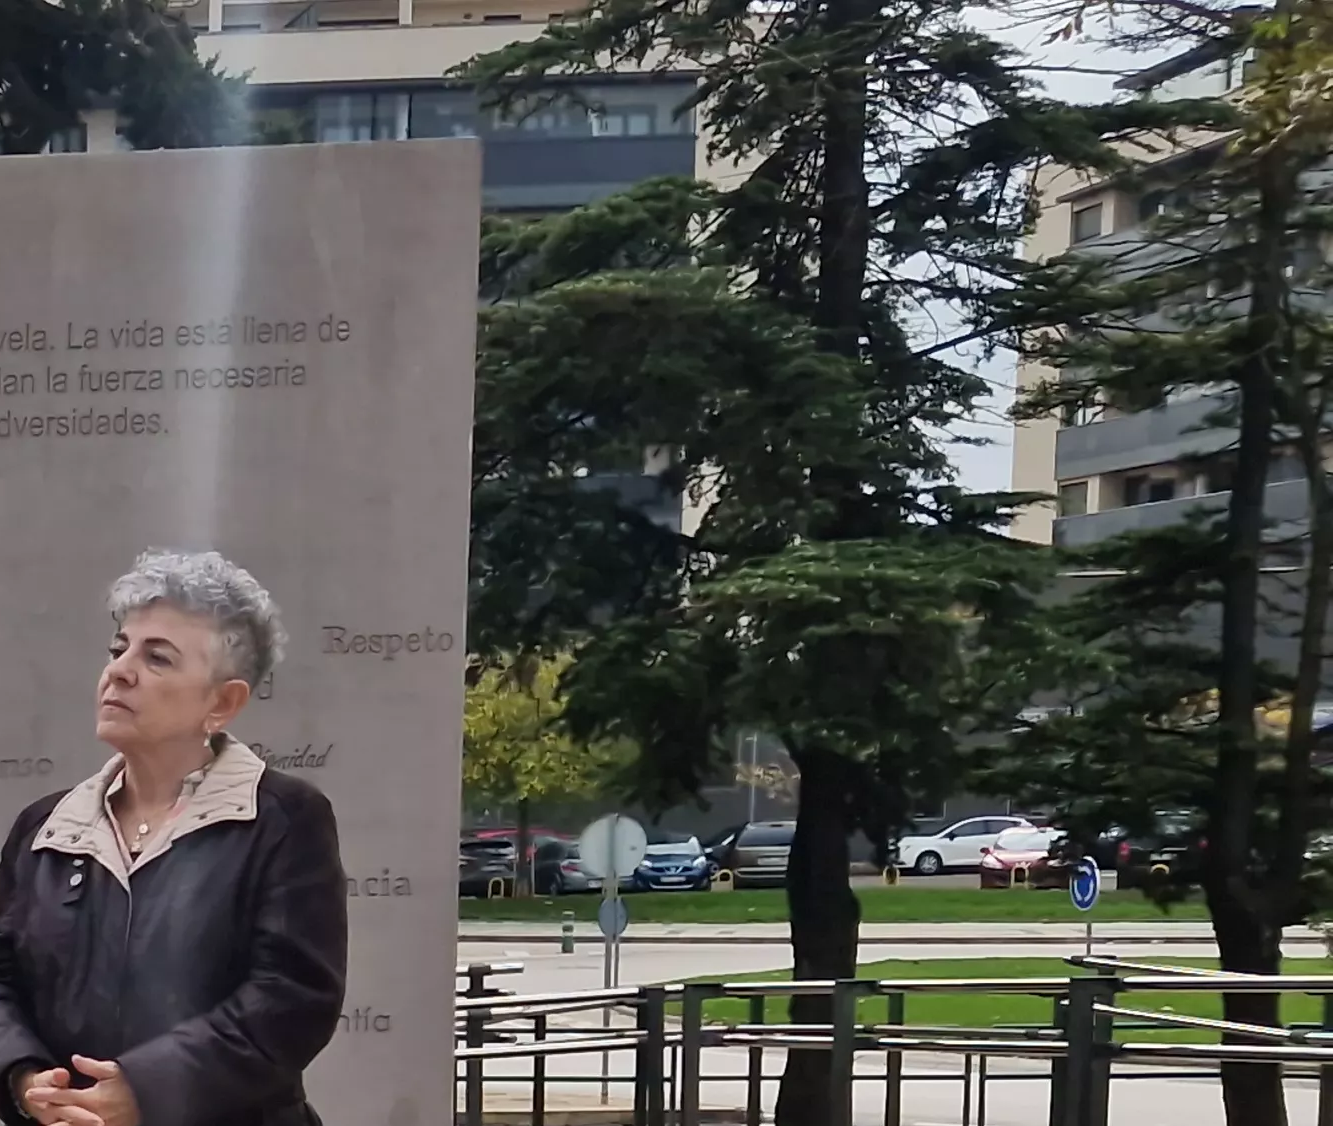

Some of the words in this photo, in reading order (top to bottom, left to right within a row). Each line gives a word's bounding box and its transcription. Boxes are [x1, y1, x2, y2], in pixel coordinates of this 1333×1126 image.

[66, 322, 99, 350] La
[110, 320, 164, 349] vida
[175, 316, 232, 346] está
[242, 316, 307, 344] llena
[318, 314, 351, 343] de
[46, 366, 68, 394] la
[79, 364, 163, 393] fuerza
[174, 359, 307, 389] necesaria
[321, 626, 454, 661] Respeto
[346, 868, 413, 897] ncia
[340, 1005, 391, 1033] ntía
